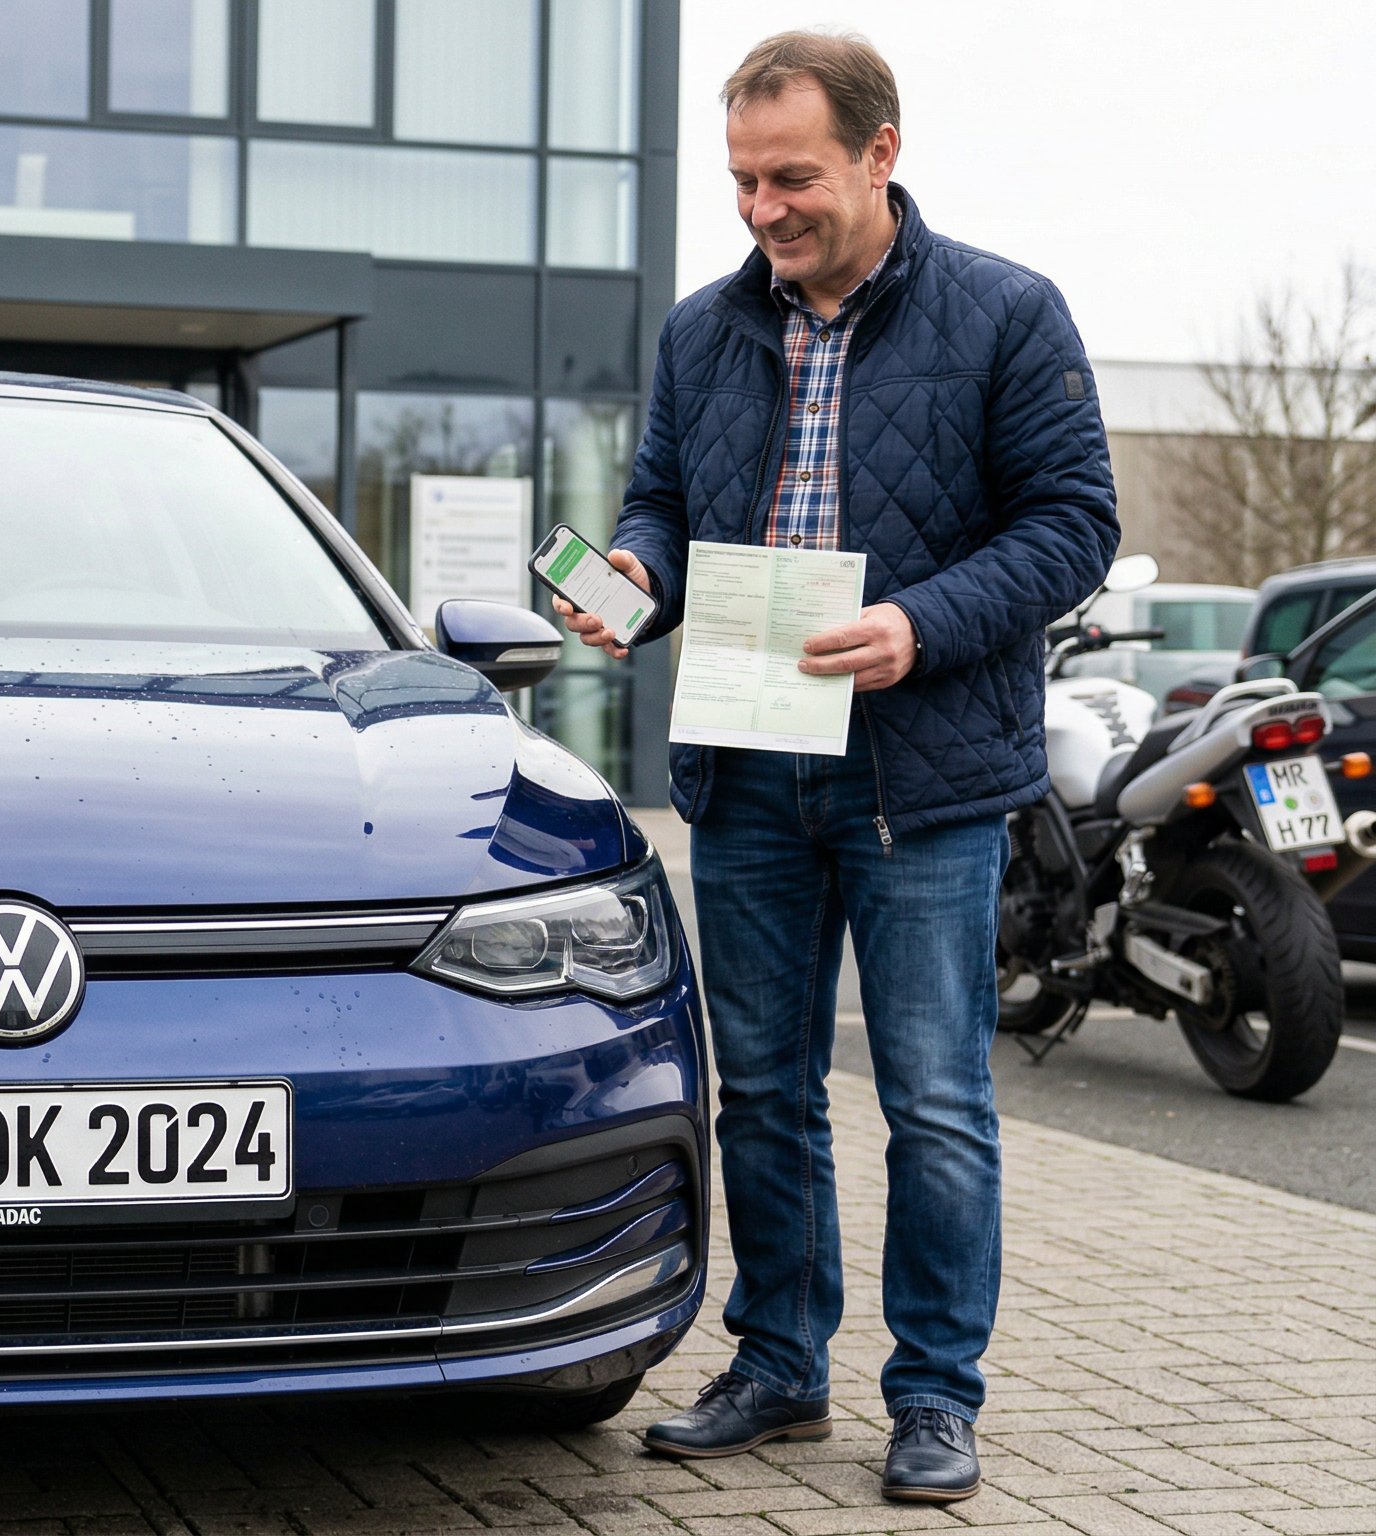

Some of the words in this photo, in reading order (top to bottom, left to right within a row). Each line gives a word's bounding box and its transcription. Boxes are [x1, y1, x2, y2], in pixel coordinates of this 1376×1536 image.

[1271, 762, 1308, 789] MR
[1277, 819, 1297, 843] H
[1300, 813, 1328, 840] 77
[88, 1101, 276, 1186] 2024
